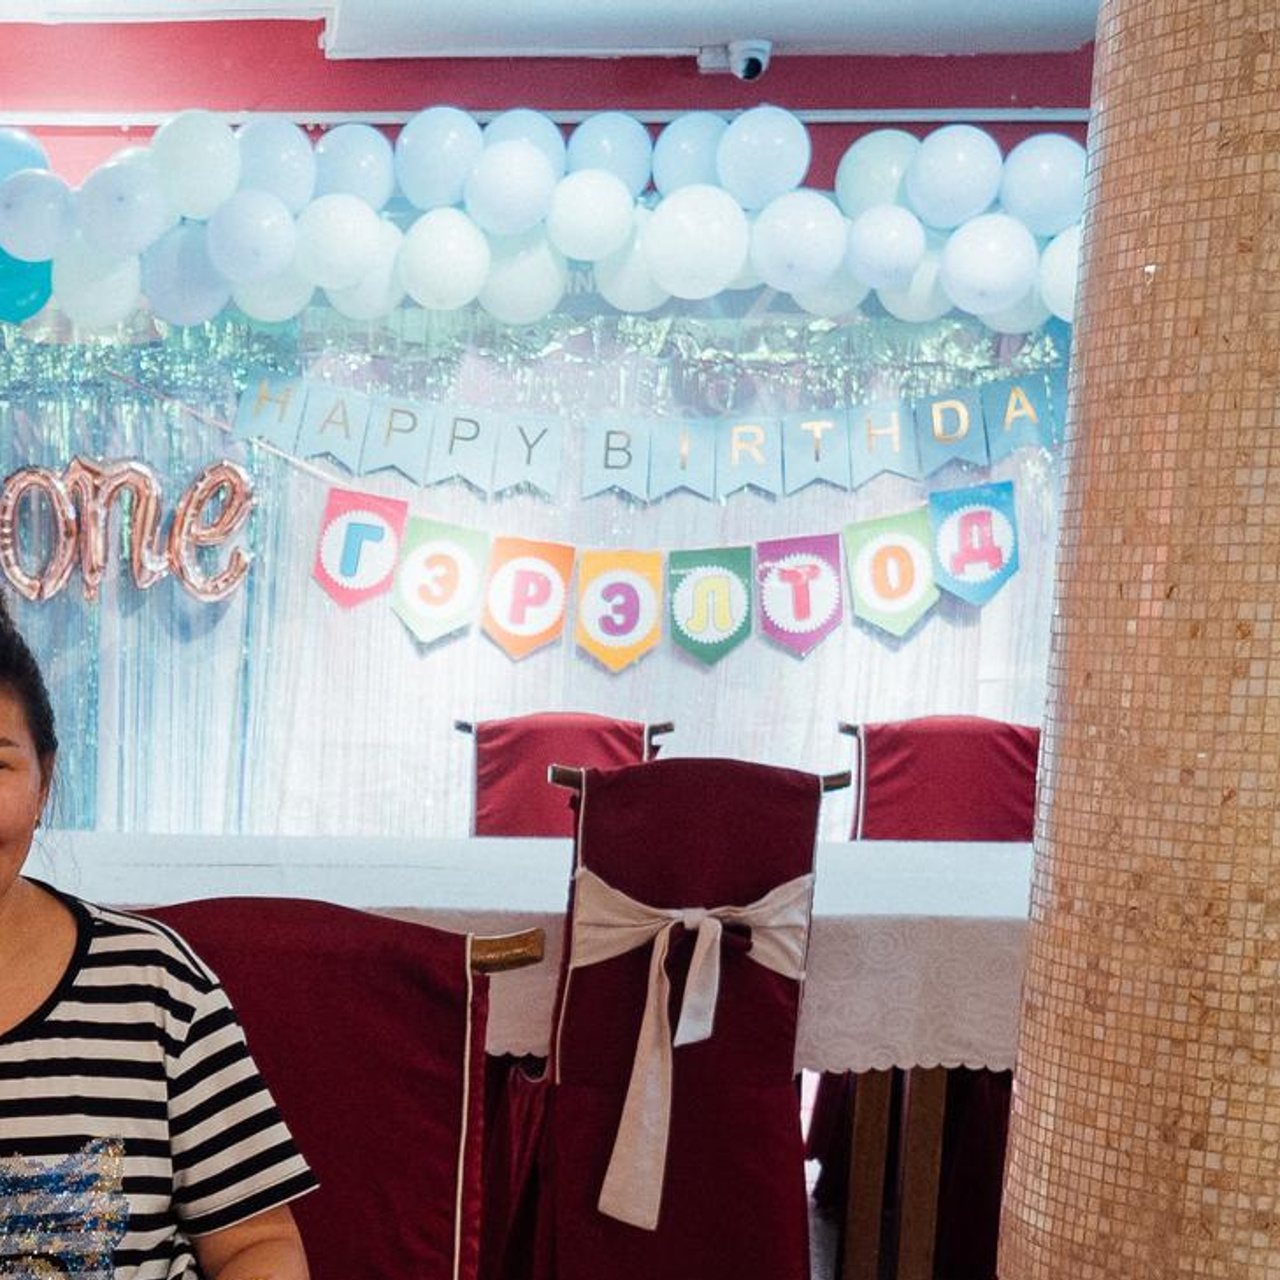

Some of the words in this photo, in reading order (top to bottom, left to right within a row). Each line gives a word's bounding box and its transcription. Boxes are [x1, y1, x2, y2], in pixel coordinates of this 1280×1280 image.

[252, 380, 548, 465] HAPPY
[602, 385, 1039, 471] BIRTHDA
[340, 509, 1004, 637] ГЭРЭЛТОД
